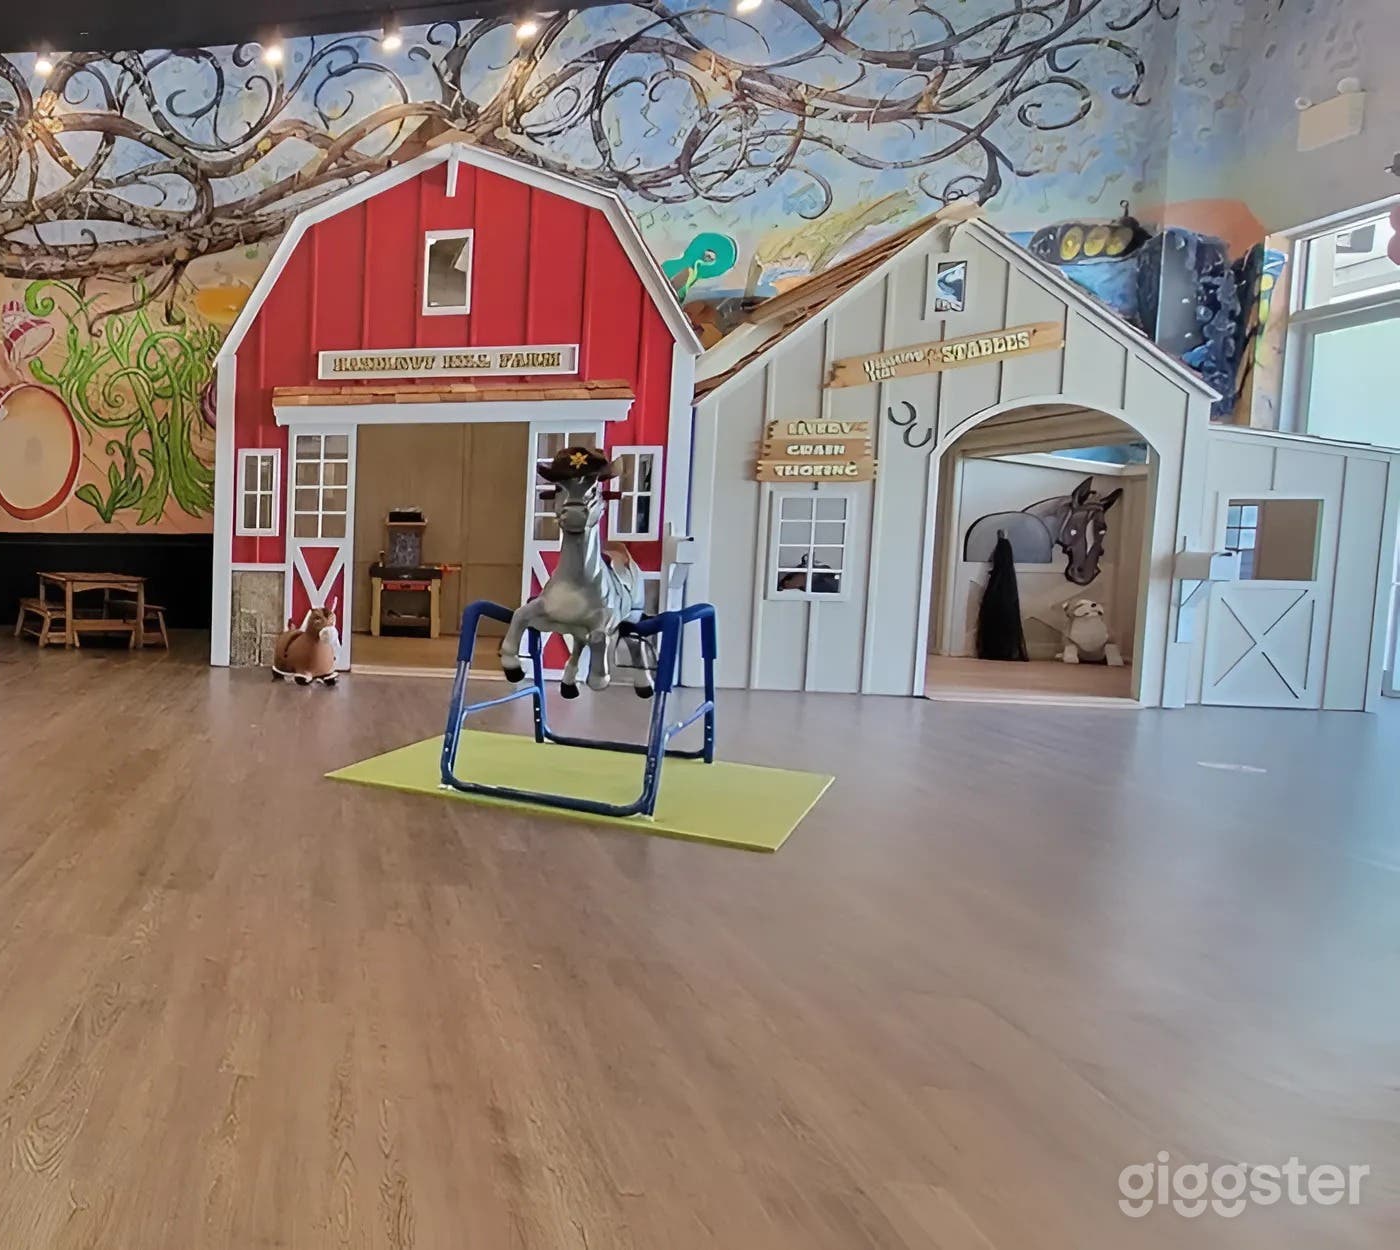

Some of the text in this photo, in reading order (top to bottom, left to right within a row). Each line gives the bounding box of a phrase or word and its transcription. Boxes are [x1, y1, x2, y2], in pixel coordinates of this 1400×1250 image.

[941, 331, 1031, 363] STABLES
[499, 352, 561, 368] FARM
[786, 444, 845, 456] GRAIN
